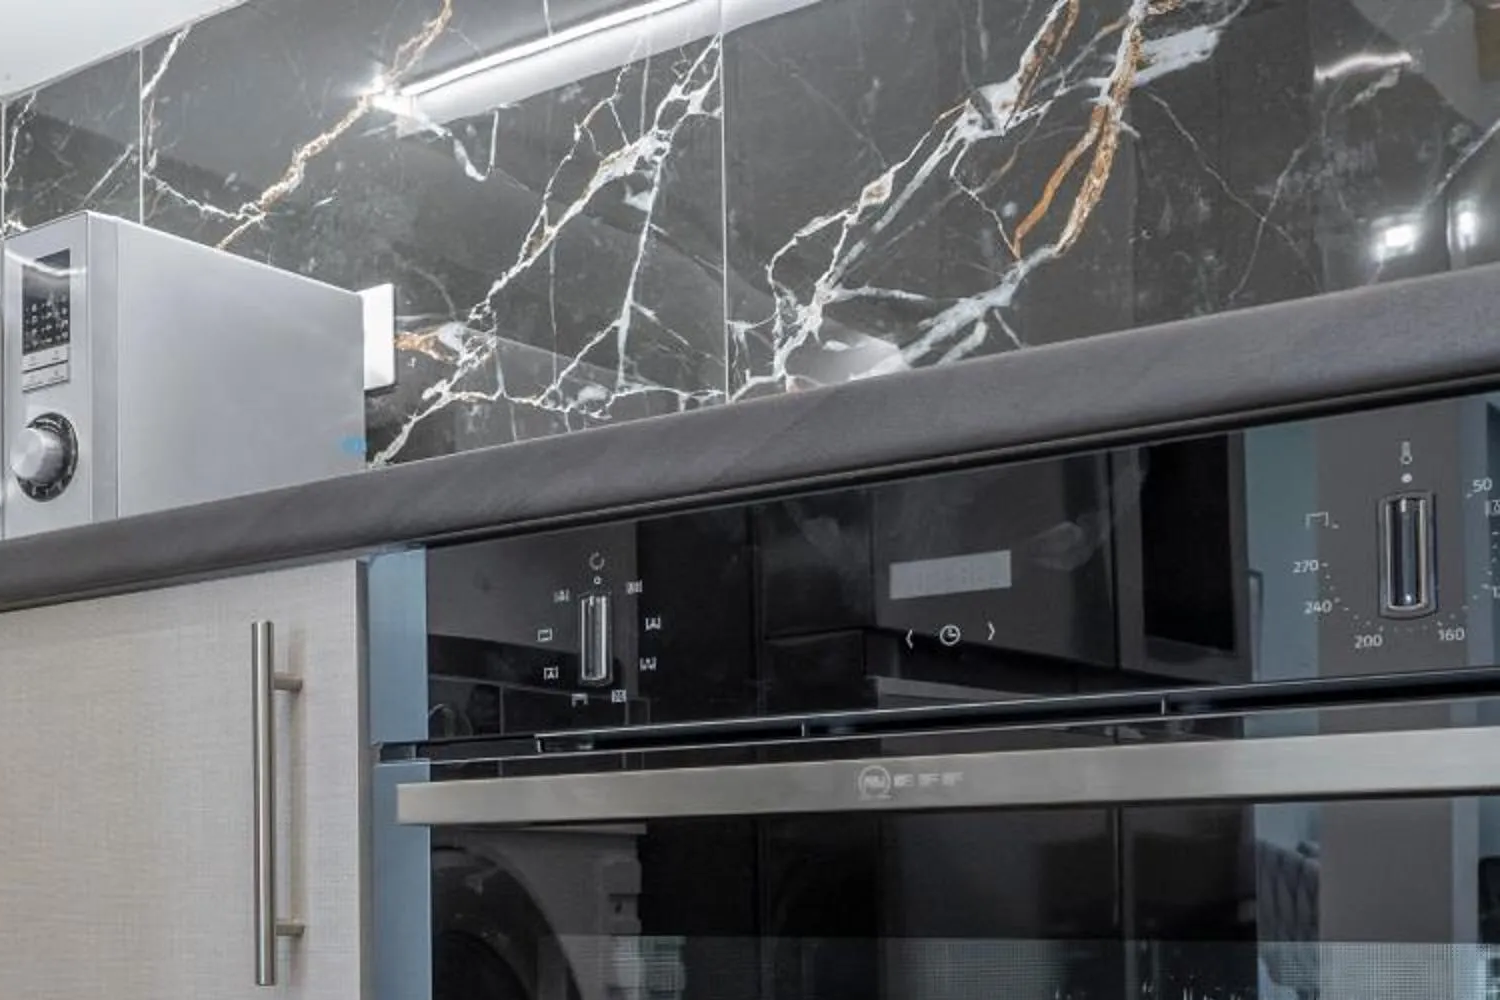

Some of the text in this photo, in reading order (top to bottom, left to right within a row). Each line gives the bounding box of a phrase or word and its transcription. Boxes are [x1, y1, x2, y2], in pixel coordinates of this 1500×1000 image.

[1473, 477, 1492, 492] 50
[1293, 560, 1319, 574] 270
[1304, 600, 1332, 614] 240
[1354, 634, 1383, 649] 200
[1438, 628, 1465, 642] 160
